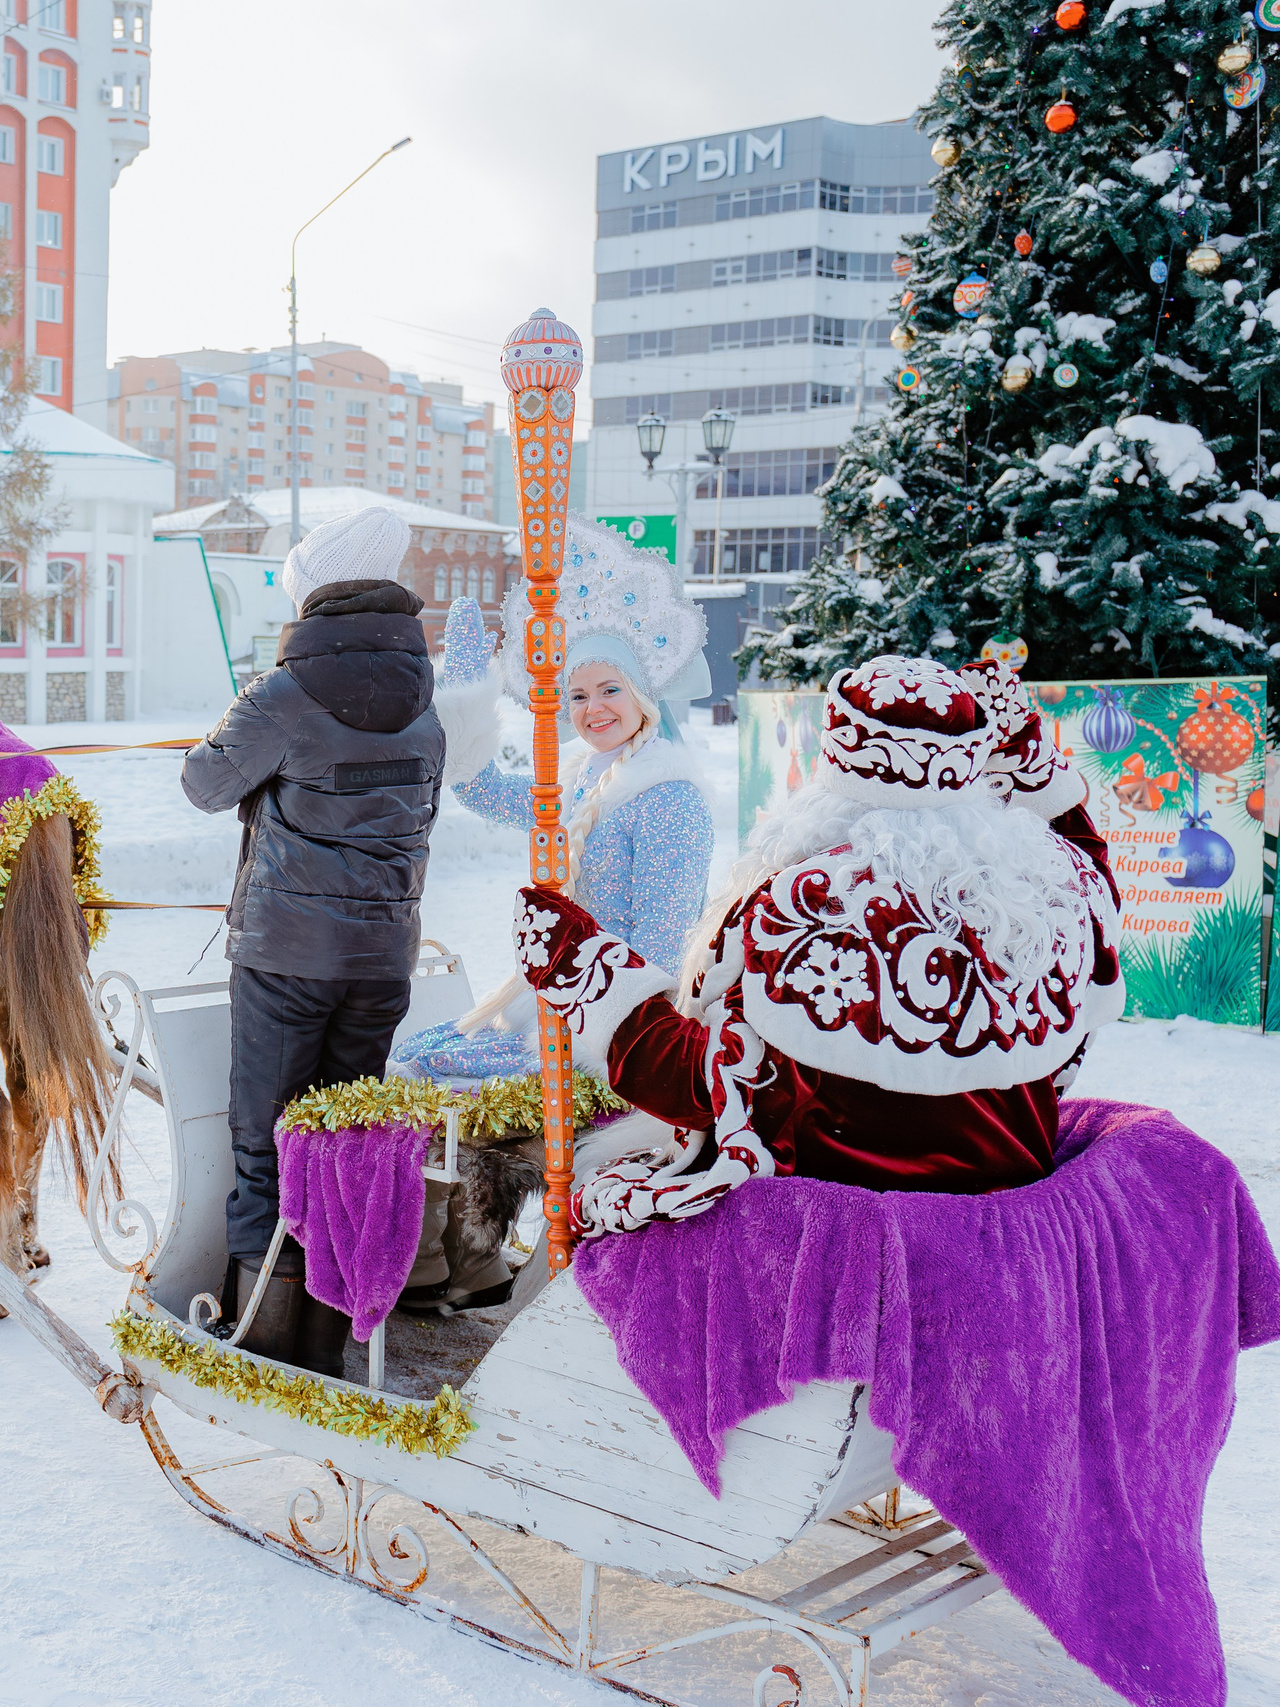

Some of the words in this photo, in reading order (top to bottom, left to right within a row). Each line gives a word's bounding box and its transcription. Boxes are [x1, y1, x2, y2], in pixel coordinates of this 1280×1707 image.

[623, 129, 785, 193] КРЫМ
[1115, 855, 1183, 876] Кирова
[1121, 913, 1190, 935] Кирова
